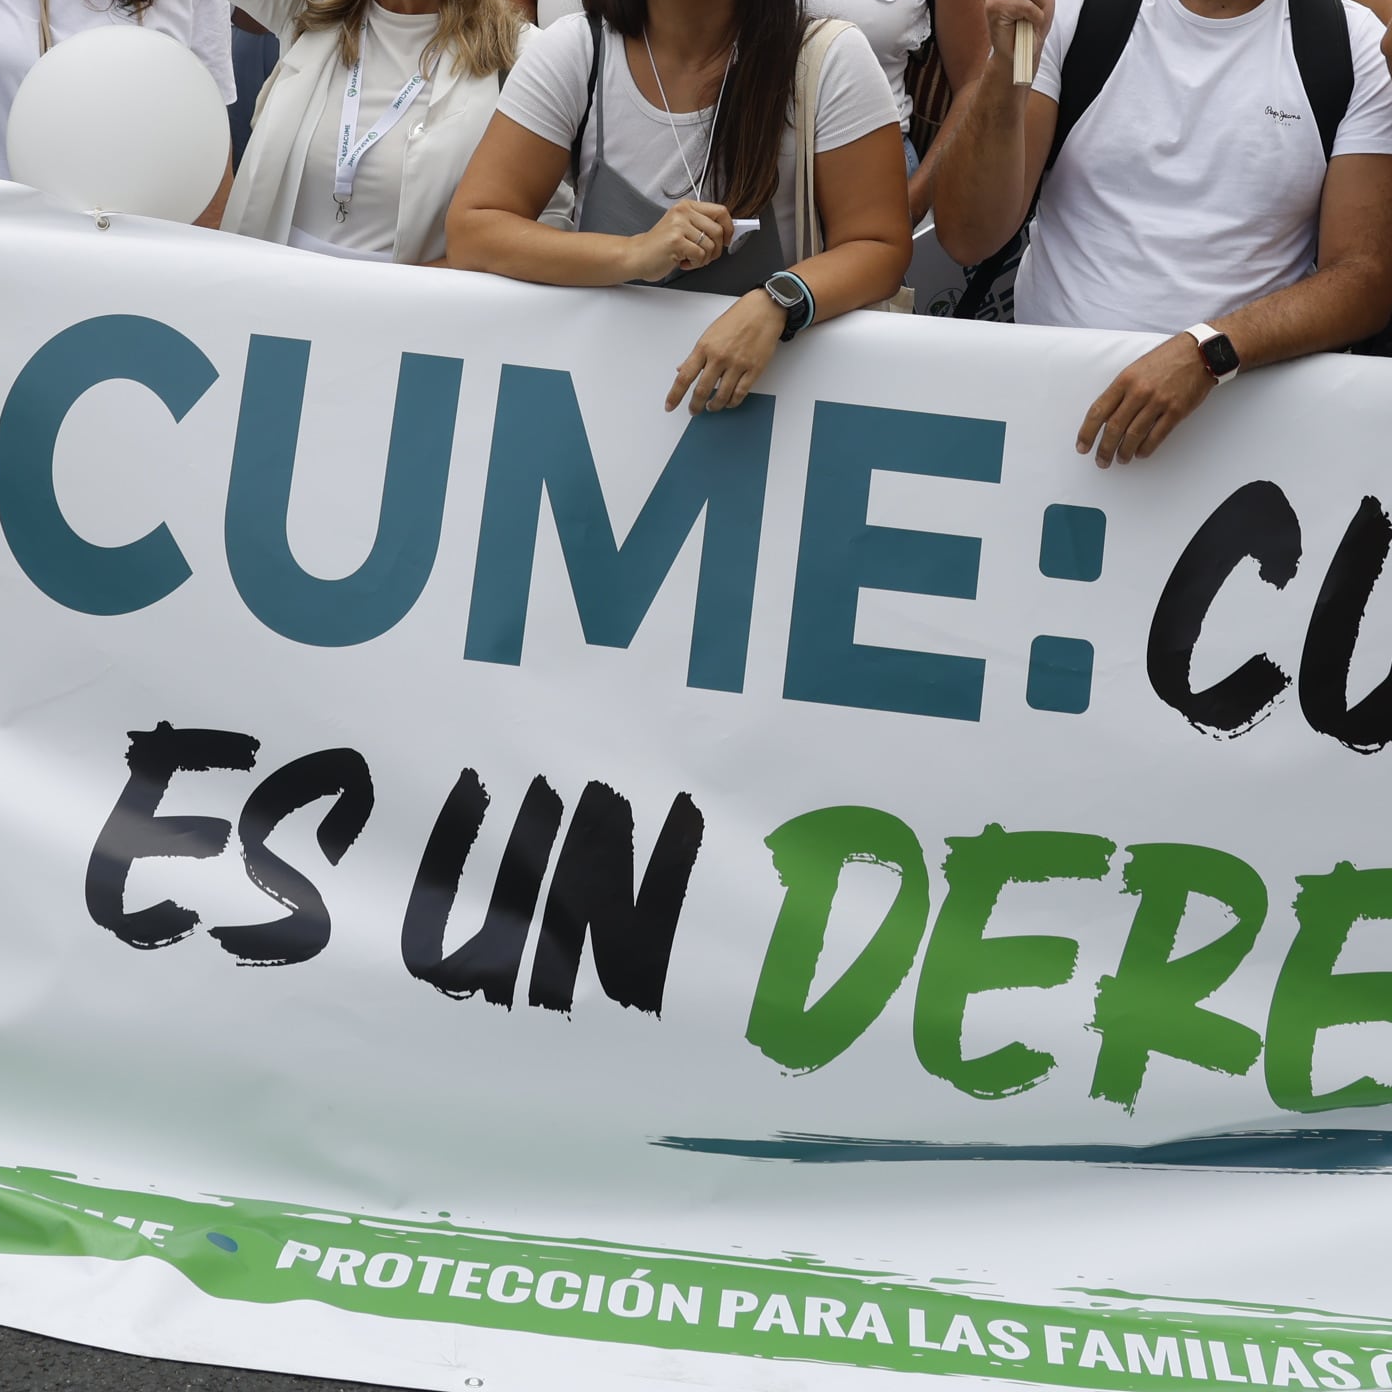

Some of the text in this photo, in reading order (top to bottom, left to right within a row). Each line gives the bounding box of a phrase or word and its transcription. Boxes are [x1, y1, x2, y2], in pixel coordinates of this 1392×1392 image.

[84, 720, 375, 968] ES
[401, 766, 706, 1022] UN
[275, 1238, 1376, 1392] PROTECCIÓN PARA LAS FAMILIAS
